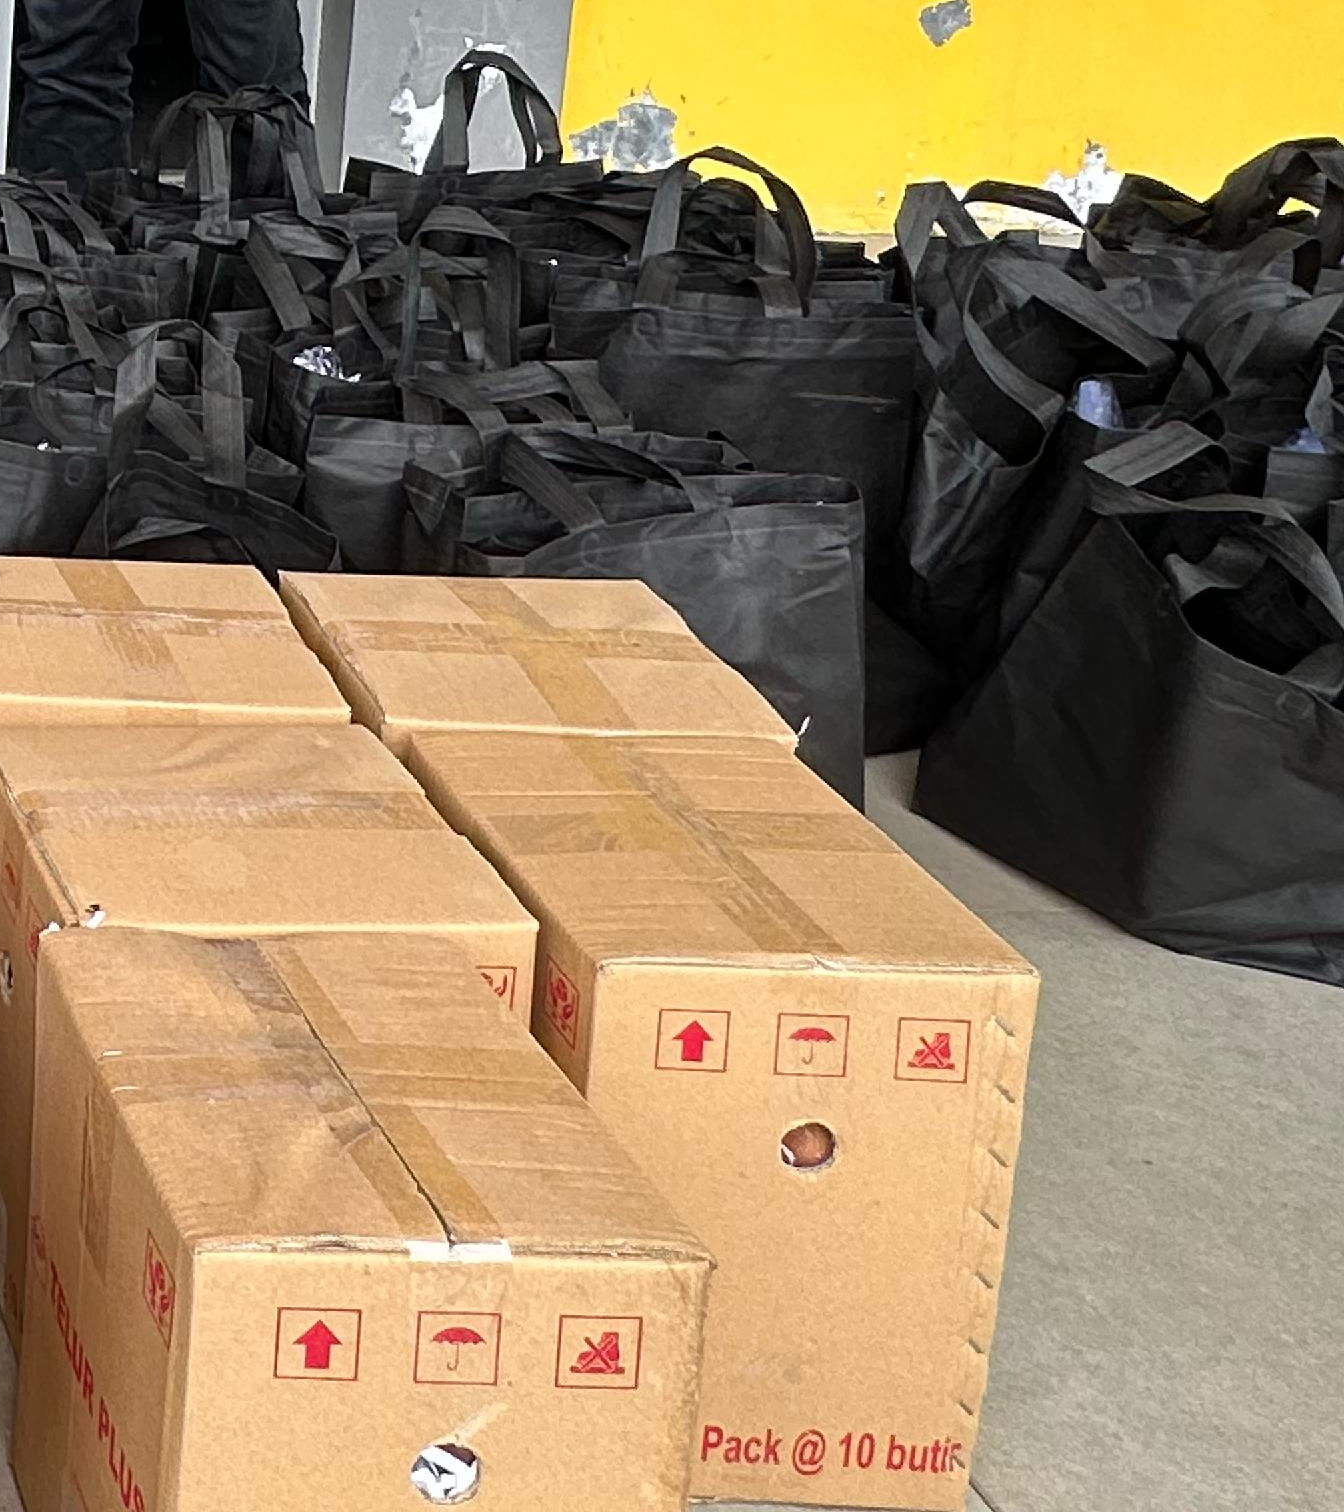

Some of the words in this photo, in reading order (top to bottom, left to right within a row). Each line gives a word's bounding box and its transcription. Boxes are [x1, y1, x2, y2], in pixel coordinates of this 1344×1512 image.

[50, 1260, 94, 1417] TELUR
[700, 1424, 783, 1465] Pack
[792, 1428, 826, 1476] @
[838, 1431, 876, 1469] 10
